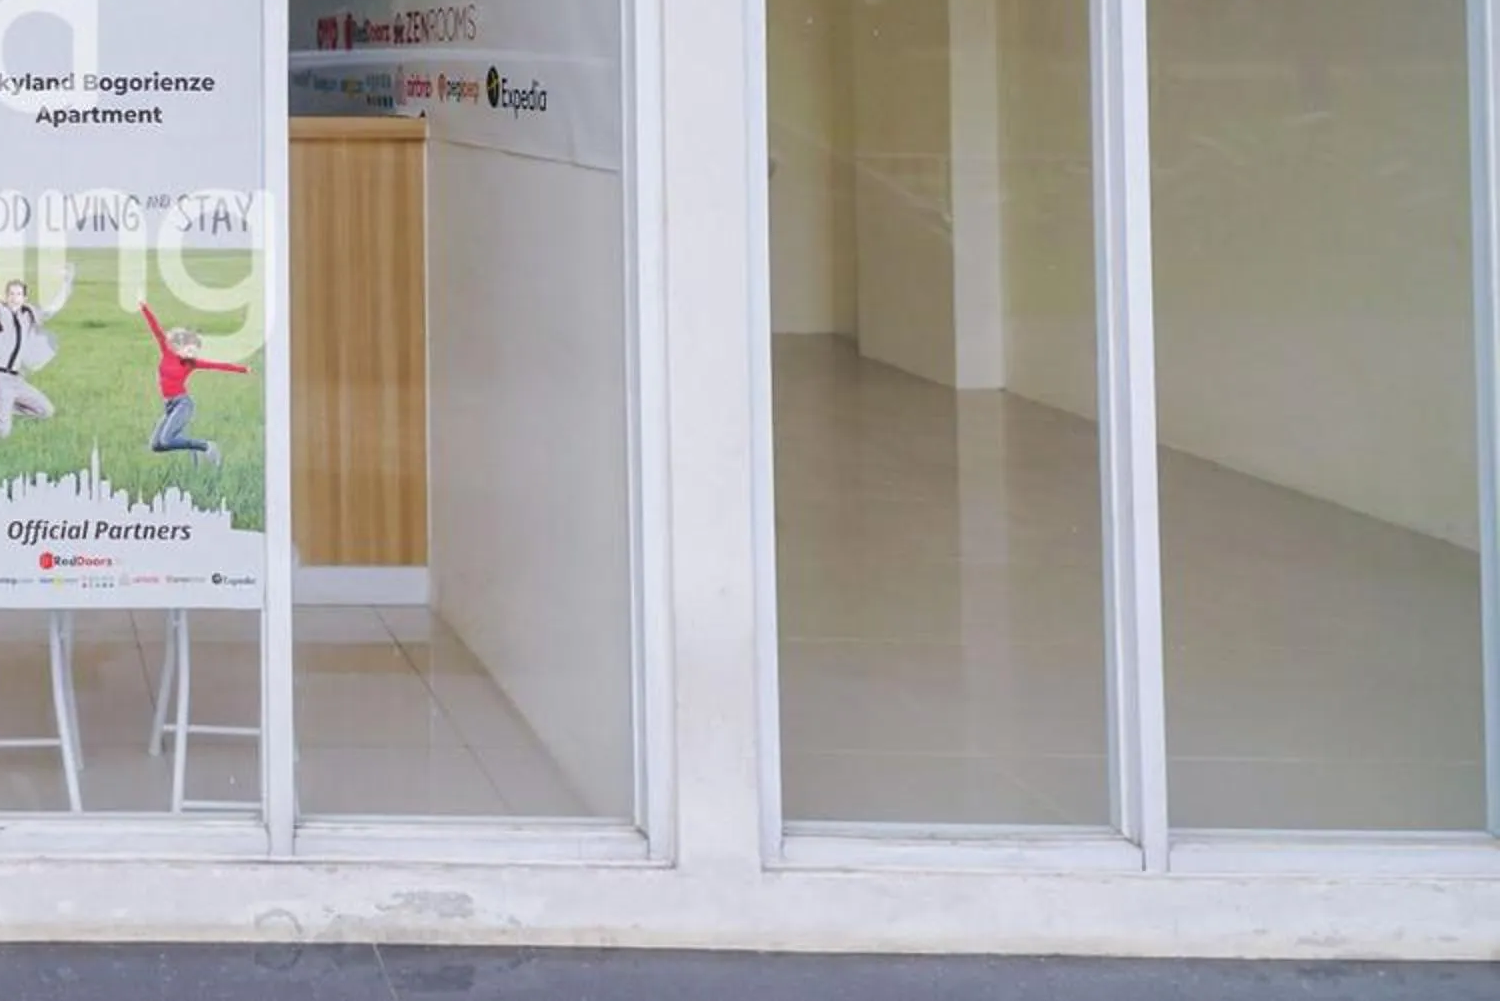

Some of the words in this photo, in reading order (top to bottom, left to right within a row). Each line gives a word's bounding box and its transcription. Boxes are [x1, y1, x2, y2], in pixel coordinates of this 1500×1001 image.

[83, 71, 216, 96] Bogorienze
[501, 78, 547, 118] Expedia
[35, 105, 163, 127] Apartment
[45, 194, 142, 232] LIVING
[175, 193, 254, 235] STAY
[7, 520, 90, 546] Official
[94, 520, 192, 542] Partners
